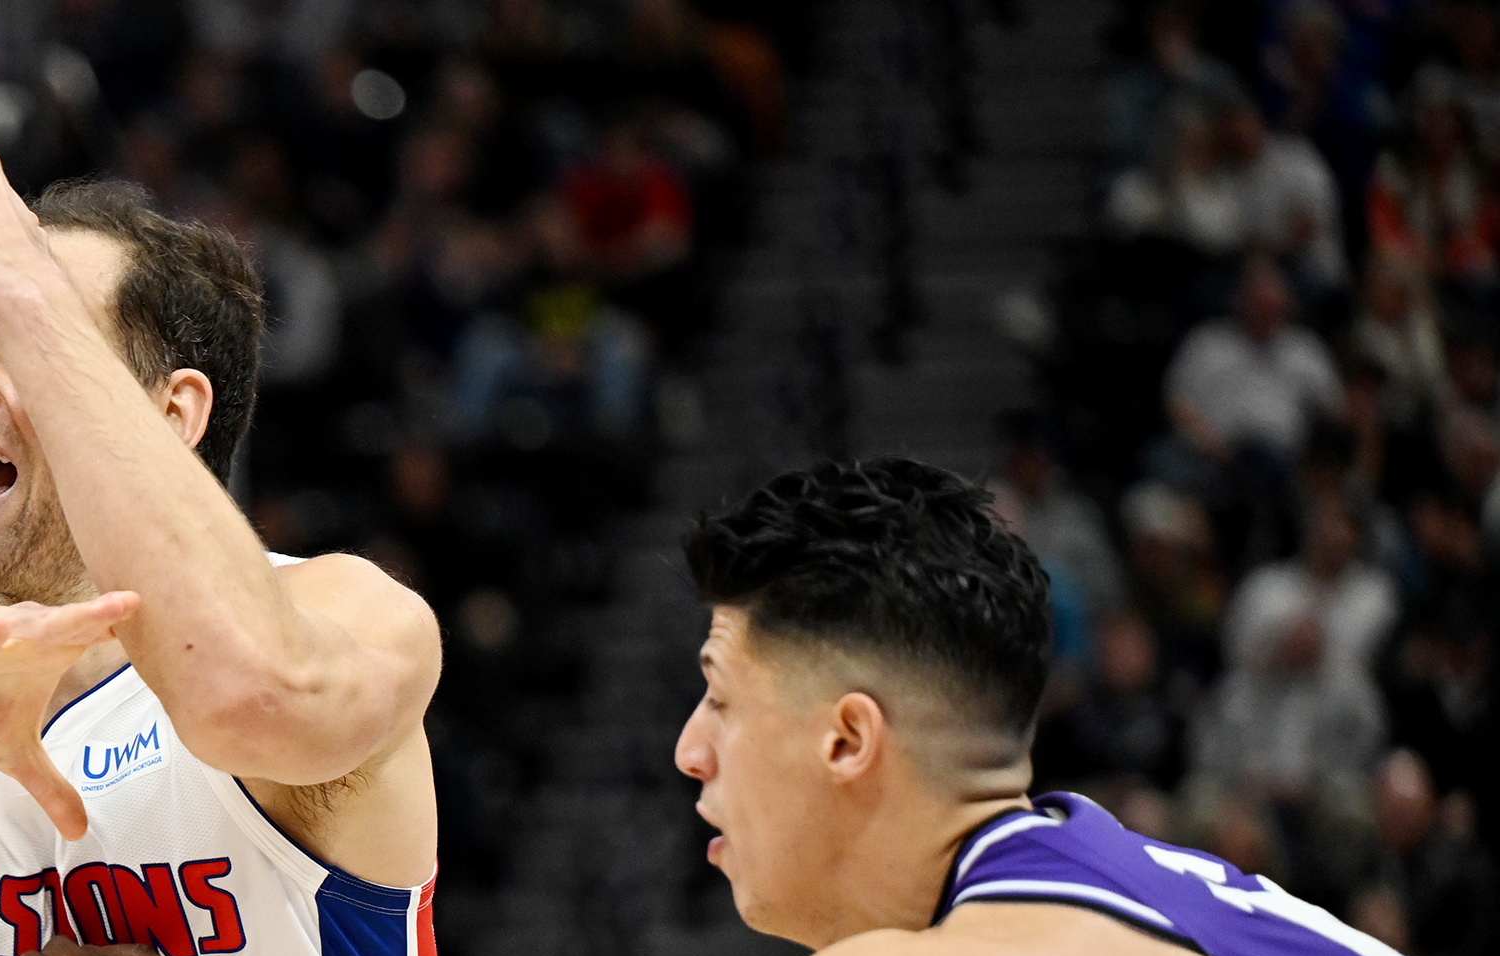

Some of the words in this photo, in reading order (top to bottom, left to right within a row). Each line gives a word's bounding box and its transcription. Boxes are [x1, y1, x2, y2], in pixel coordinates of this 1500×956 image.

[83, 719, 160, 779] UWM
[81, 784, 104, 792] UNITED
[132, 755, 163, 773] MORTGAGE
